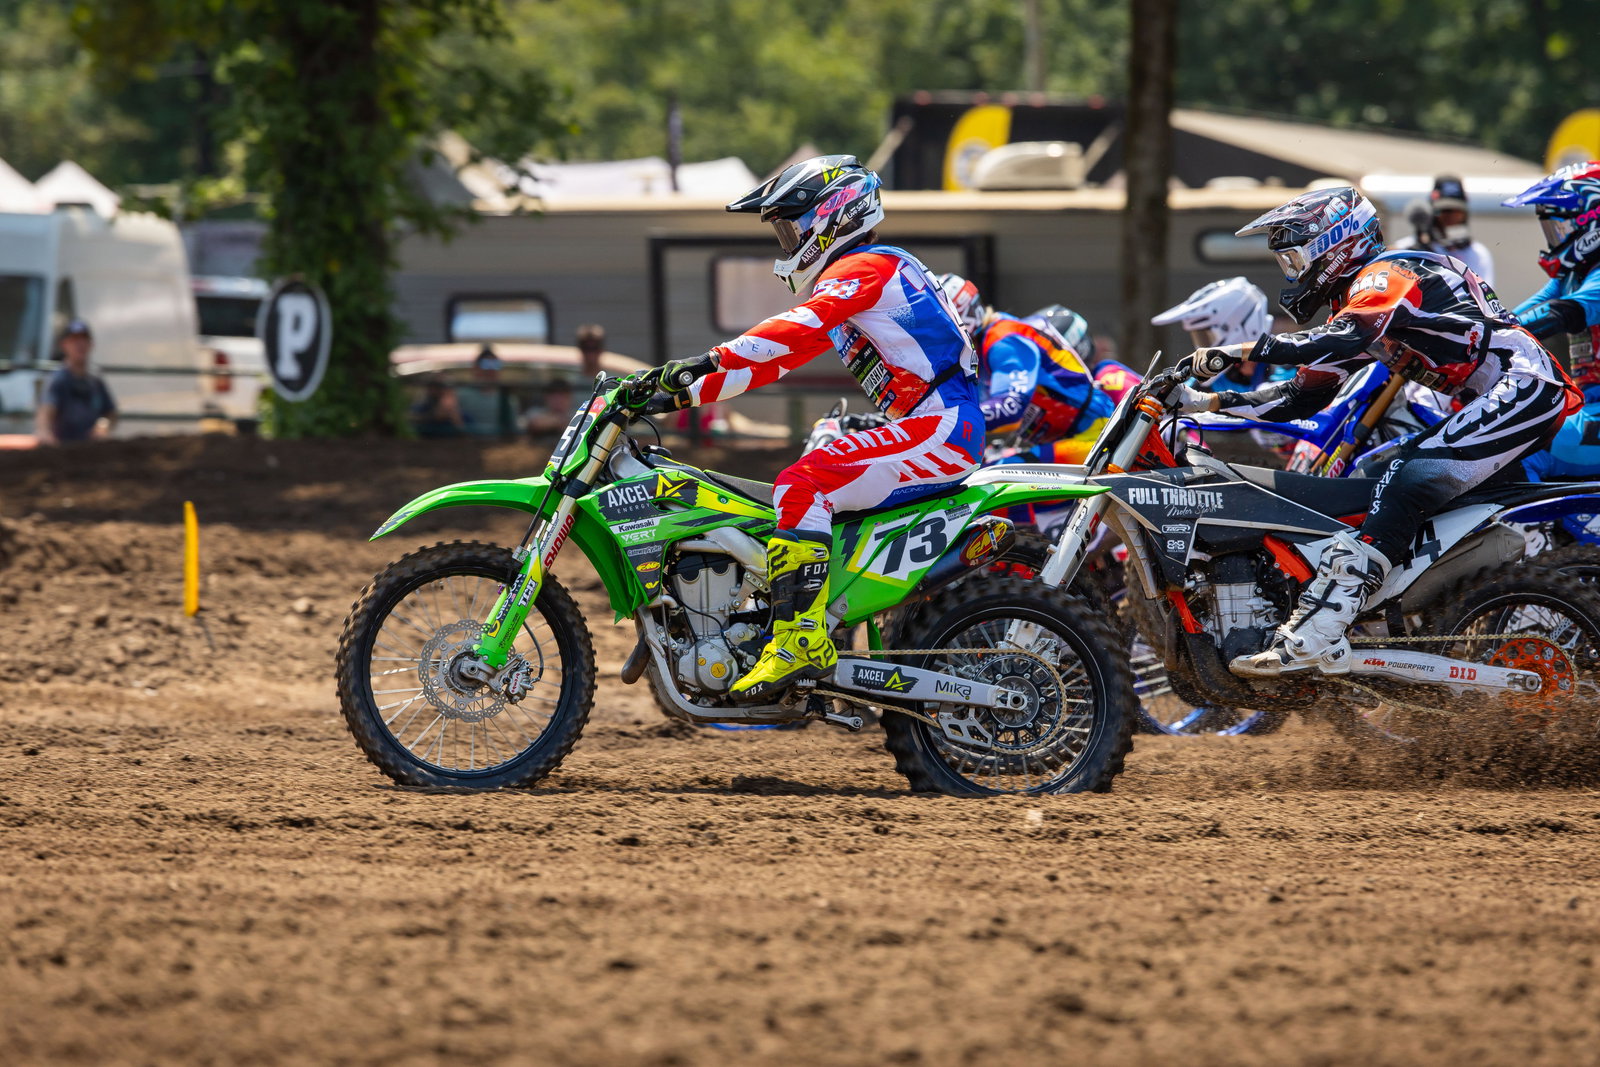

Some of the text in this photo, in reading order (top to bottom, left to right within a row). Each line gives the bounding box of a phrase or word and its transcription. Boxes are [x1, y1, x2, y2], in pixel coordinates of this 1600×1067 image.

[1324, 197, 1349, 224] 46
[1308, 214, 1360, 260] 100%
[801, 243, 820, 263] AXCEL
[1317, 250, 1348, 285] FULL THROTTLE
[277, 293, 318, 380] P
[607, 484, 654, 508] AXCEL
[1128, 488, 1224, 509] FULL THROTTLE
[617, 503, 650, 514] ENERGY
[618, 519, 655, 532] Kawasaki
[620, 528, 656, 541] VERT
[544, 513, 575, 569] SHOWA
[874, 516, 948, 576] 73
[804, 562, 829, 576] FOX
[858, 668, 885, 682] AXCEL
[1363, 658, 1435, 672] KTM POWERPARTS
[745, 682, 764, 698] FOX
[935, 680, 972, 697] Mika
